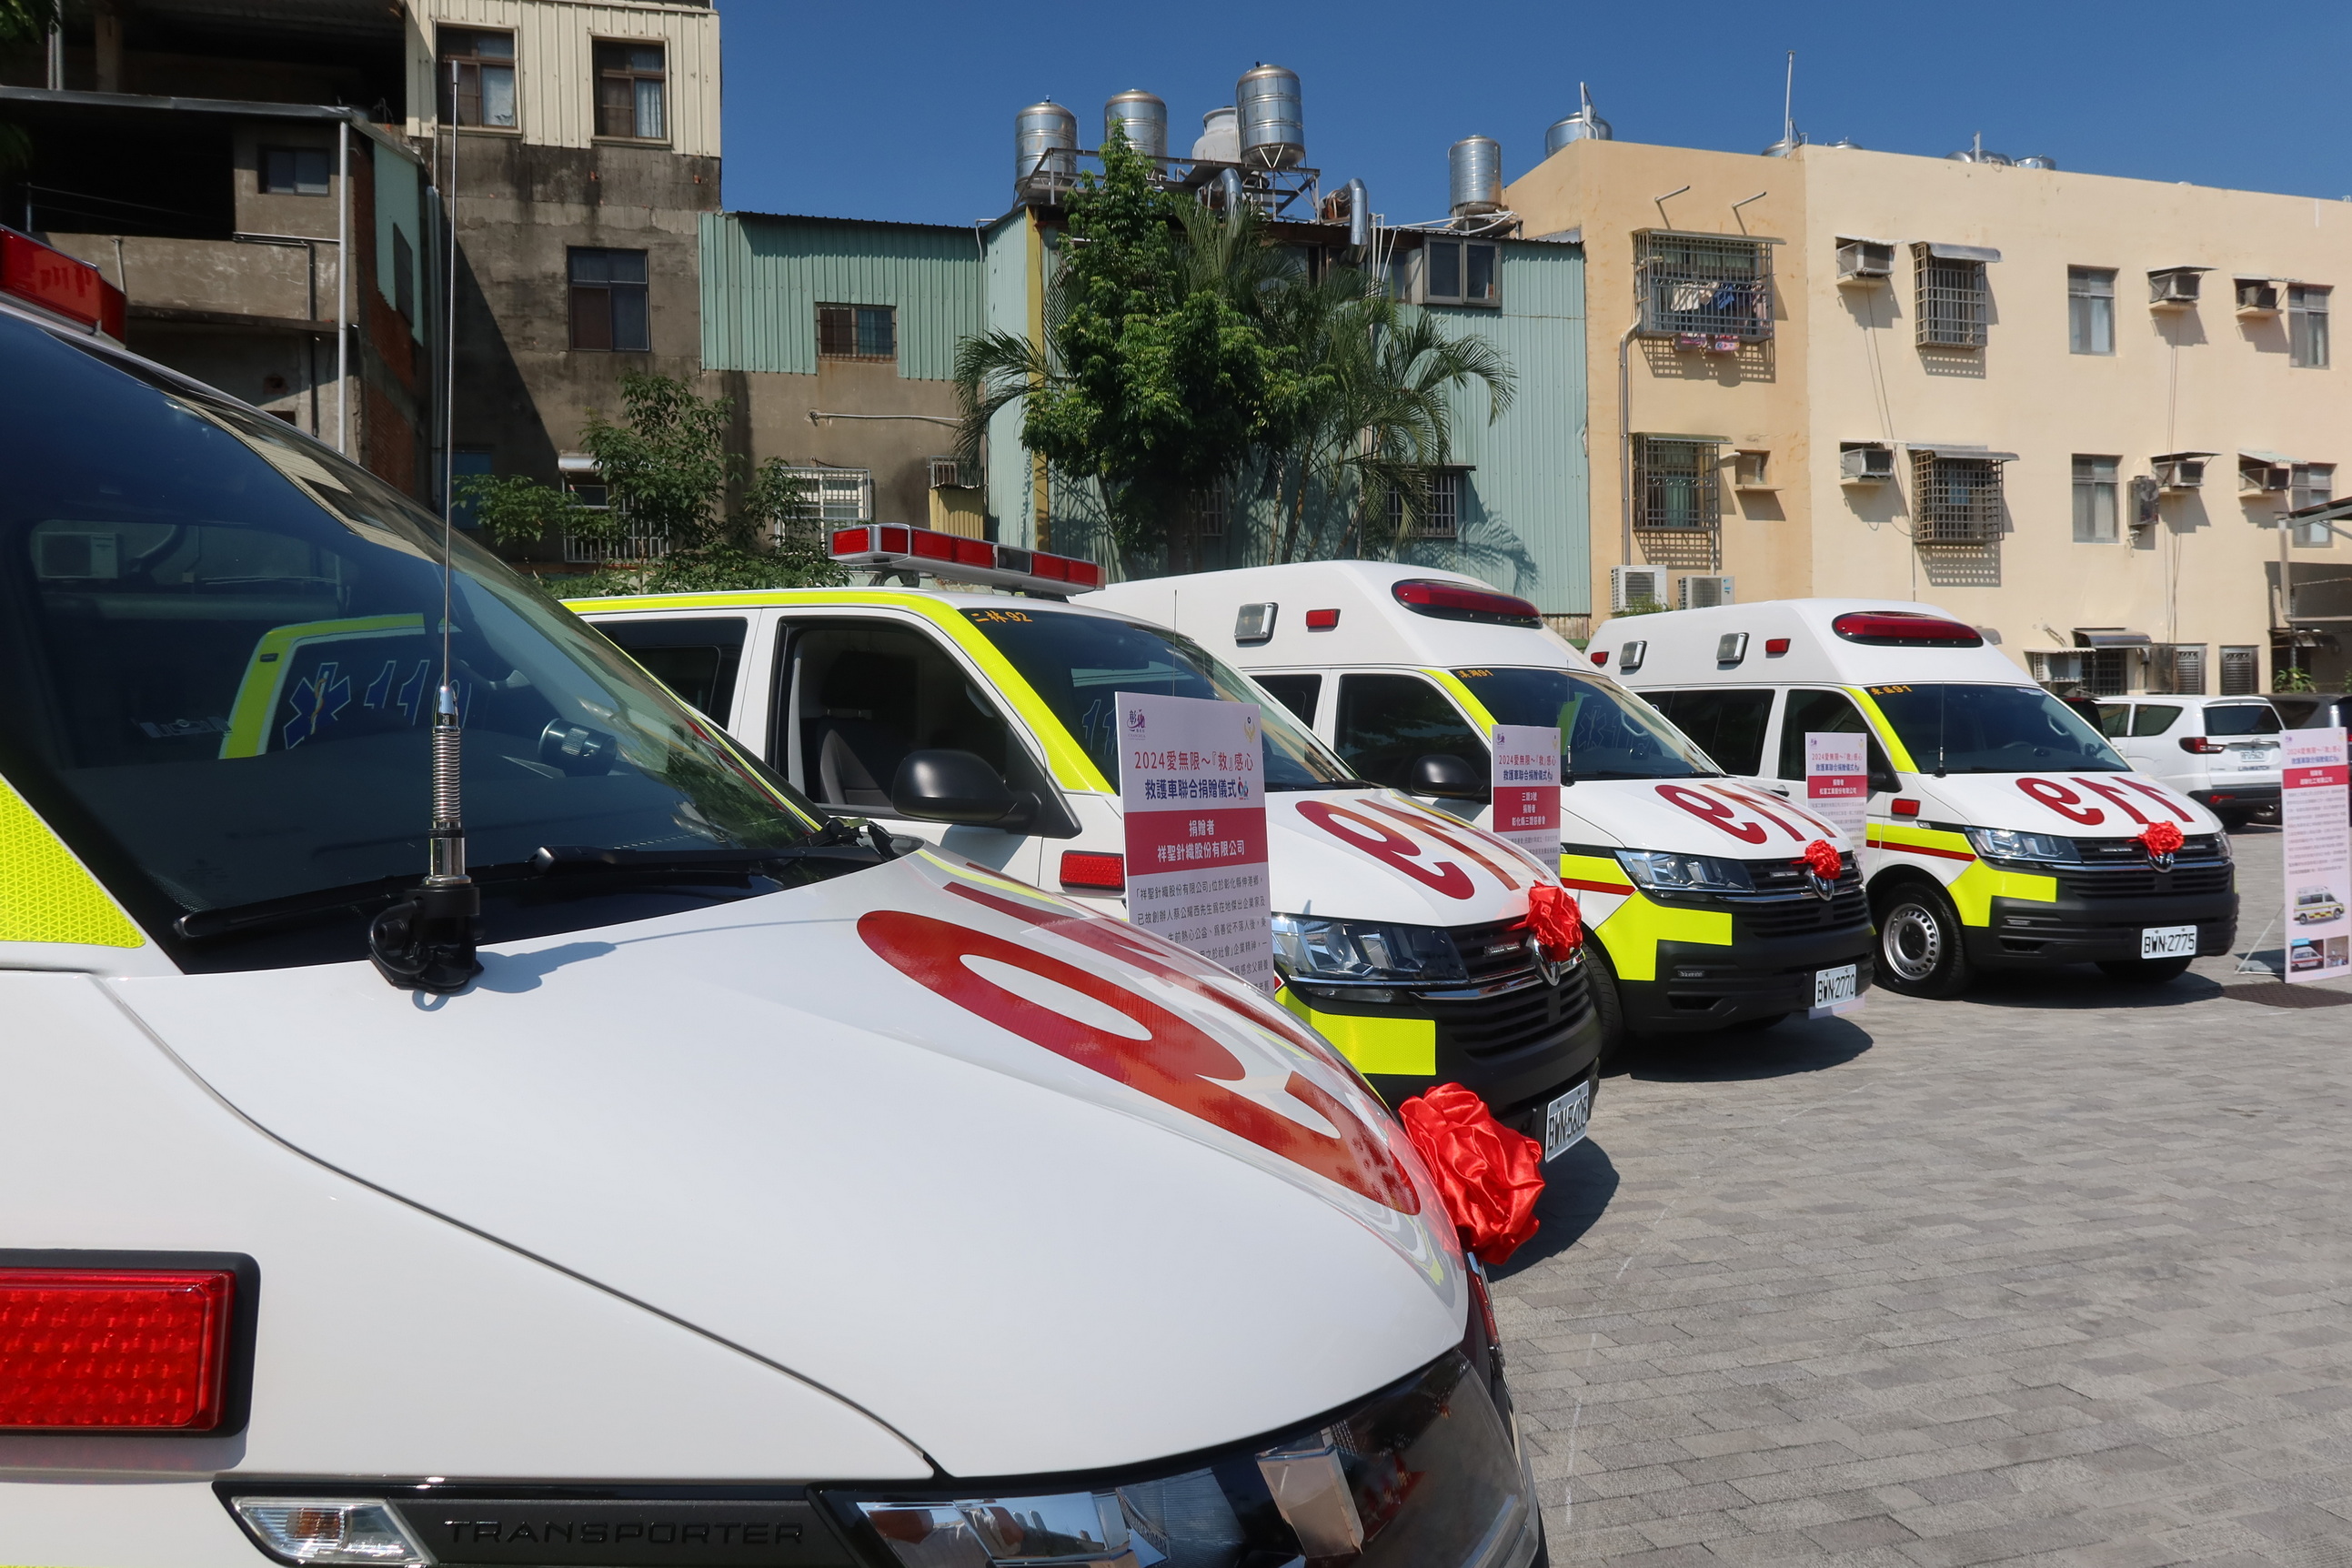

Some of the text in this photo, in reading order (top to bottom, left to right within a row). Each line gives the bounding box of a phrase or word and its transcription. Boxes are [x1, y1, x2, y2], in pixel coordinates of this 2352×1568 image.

[970, 609, 1033, 623] 二林92
[1144, 778, 1237, 800] 救護車聯合捐贈儀式
[1189, 819, 1215, 838] 捐贈者
[1157, 839, 1245, 863] 祥聖針織股份有限公司
[2144, 932, 2196, 954] BWN-2775
[1817, 973, 1855, 1002] BWN-2770
[444, 1520, 804, 1544] TRANSPORTER
